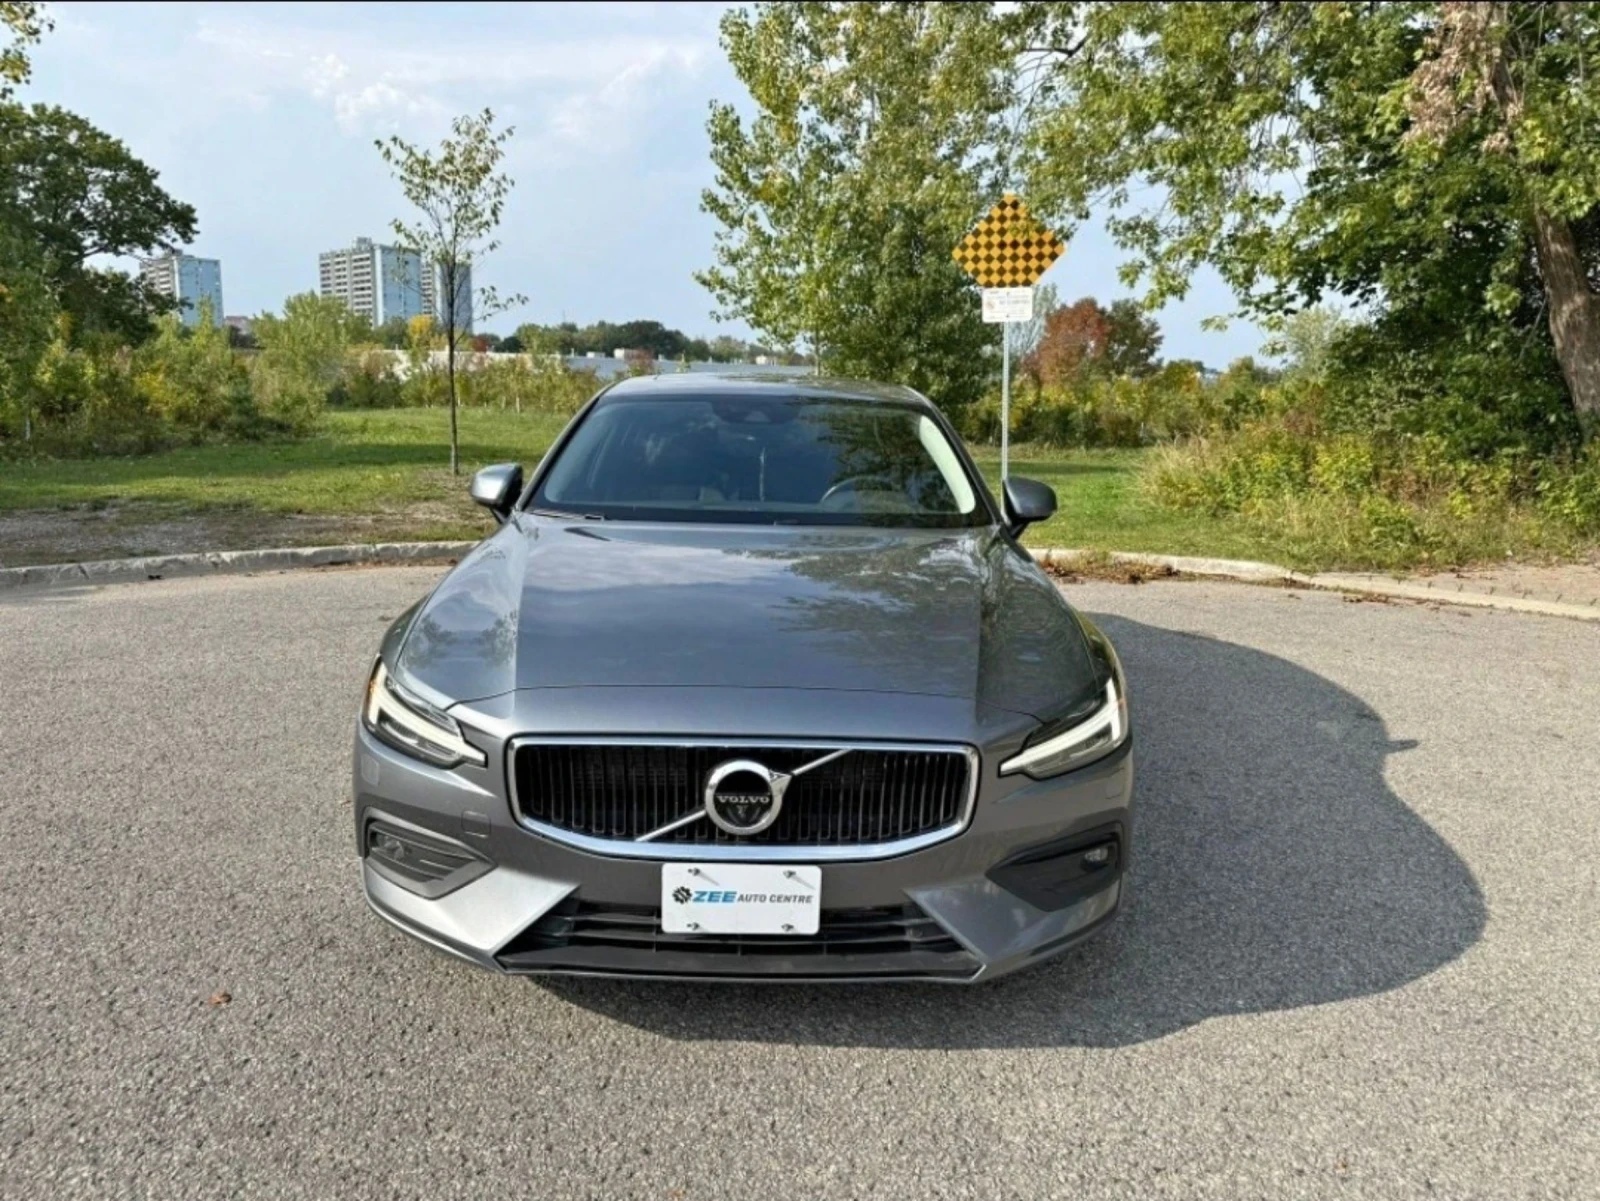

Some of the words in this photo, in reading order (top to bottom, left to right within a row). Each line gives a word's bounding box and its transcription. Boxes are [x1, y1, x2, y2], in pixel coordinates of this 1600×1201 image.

[716, 795, 770, 803] VOLVO
[692, 890, 738, 903] ZEE
[737, 893, 767, 903] AUTO
[769, 894, 814, 904] CENTRE
